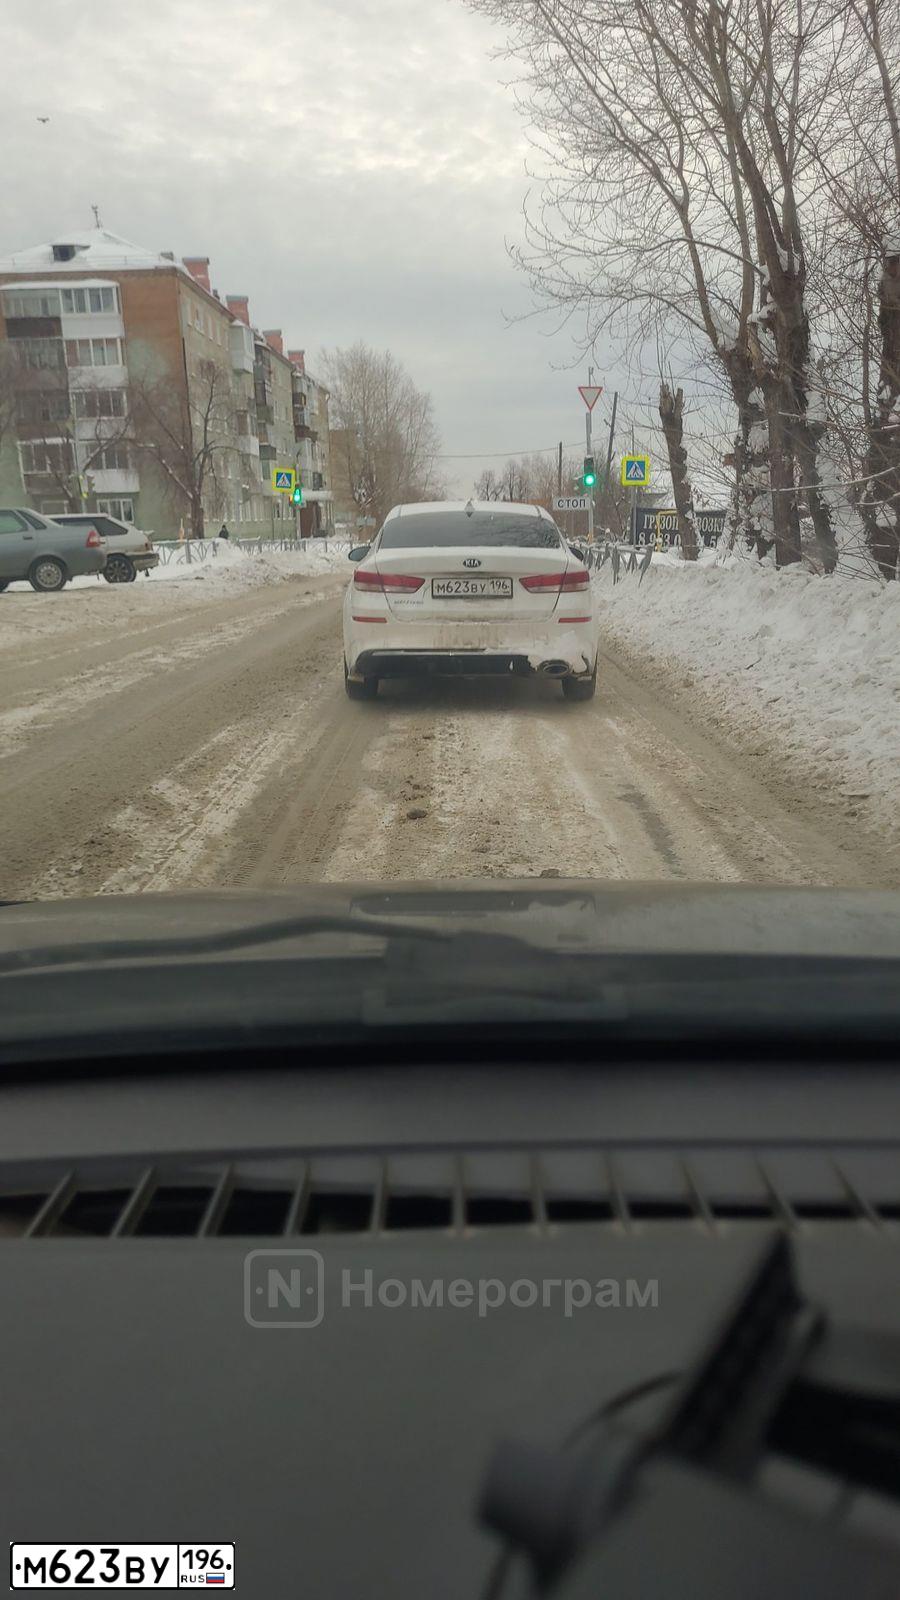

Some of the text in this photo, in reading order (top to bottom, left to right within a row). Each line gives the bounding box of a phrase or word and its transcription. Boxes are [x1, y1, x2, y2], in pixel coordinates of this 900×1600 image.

[557, 499, 586, 508] СТОП
[465, 559, 479, 567] KIA
[436, 580, 507, 593] М623ВУ 196
